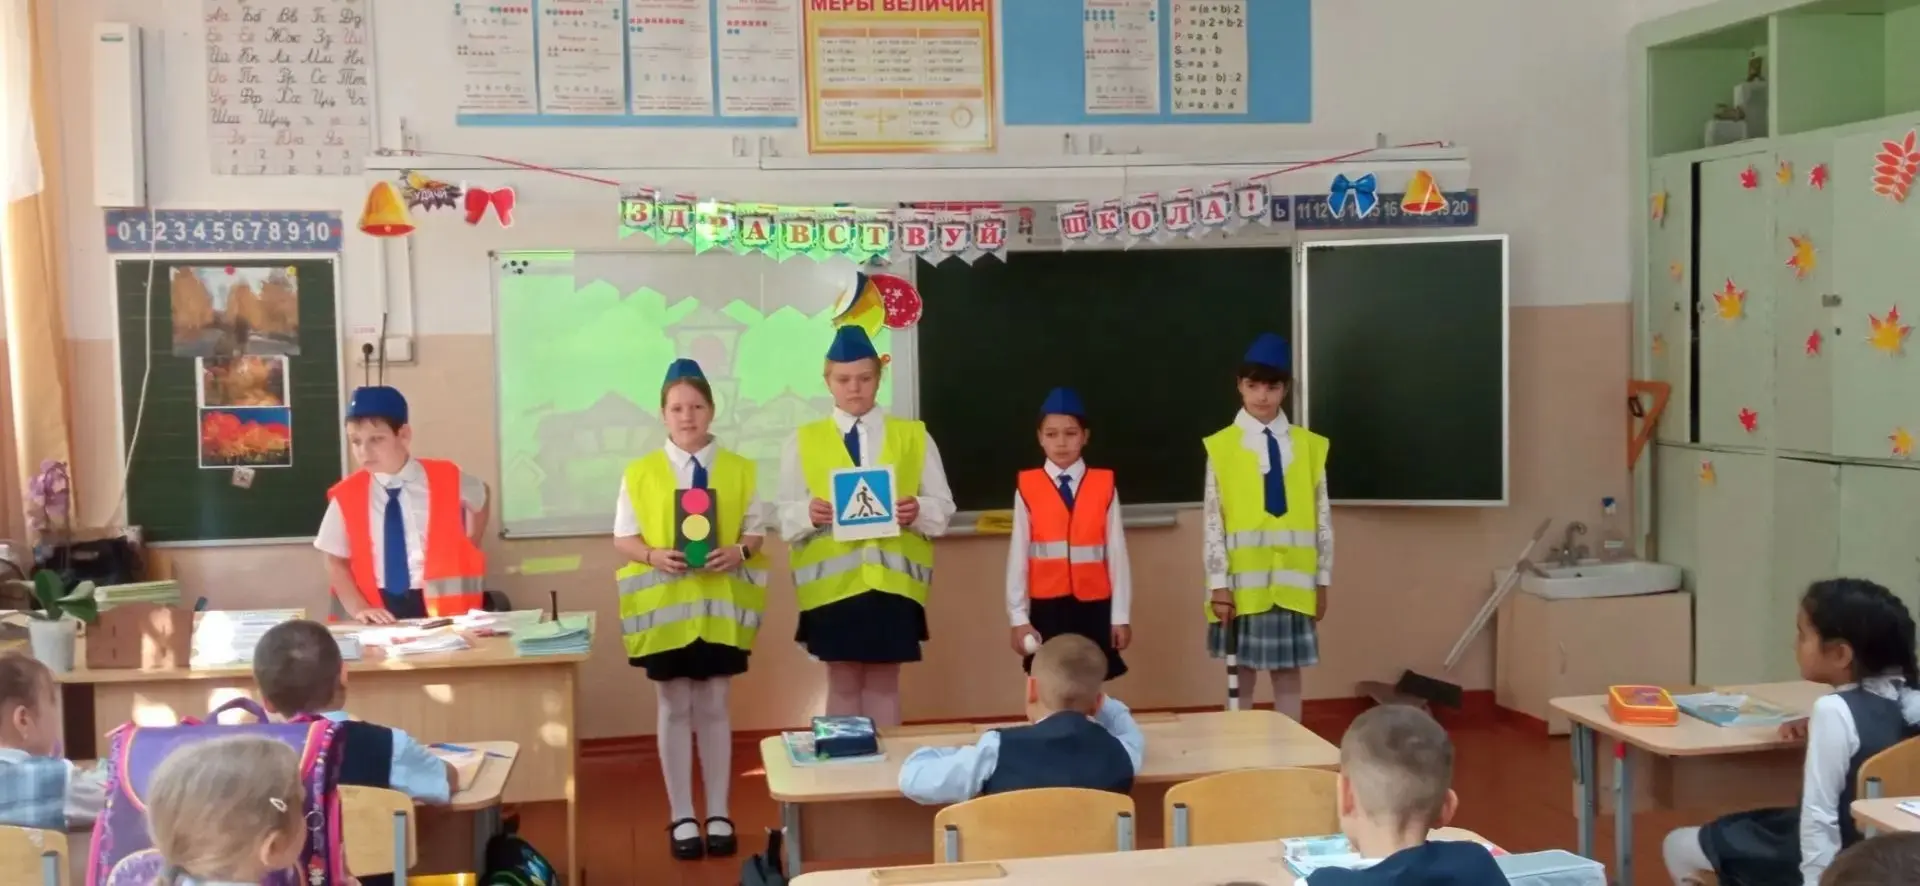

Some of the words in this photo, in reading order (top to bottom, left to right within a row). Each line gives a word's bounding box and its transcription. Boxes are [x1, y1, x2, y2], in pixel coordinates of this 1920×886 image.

[811, 0, 874, 11] МЕРЫ
[883, 0, 984, 12] ВЕЛИЧИН
[415, 188, 448, 201] УДАЧИ
[1063, 193, 1254, 234] ШКОЛА!
[1297, 204, 1310, 219] 11
[1313, 203, 1327, 218] 12
[1383, 201, 1397, 217] 16
[1452, 200, 1468, 216] 20
[117, 222, 131, 241] 0
[136, 222, 147, 241] 1
[155, 222, 168, 241] 2
[174, 222, 186, 241] 3
[193, 222, 207, 241] 4
[213, 222, 225, 241] 5
[232, 222, 244, 241] 6
[251, 222, 263, 241] 7
[268, 222, 281, 241] 8
[287, 222, 300, 241] 9
[306, 222, 329, 241] 10
